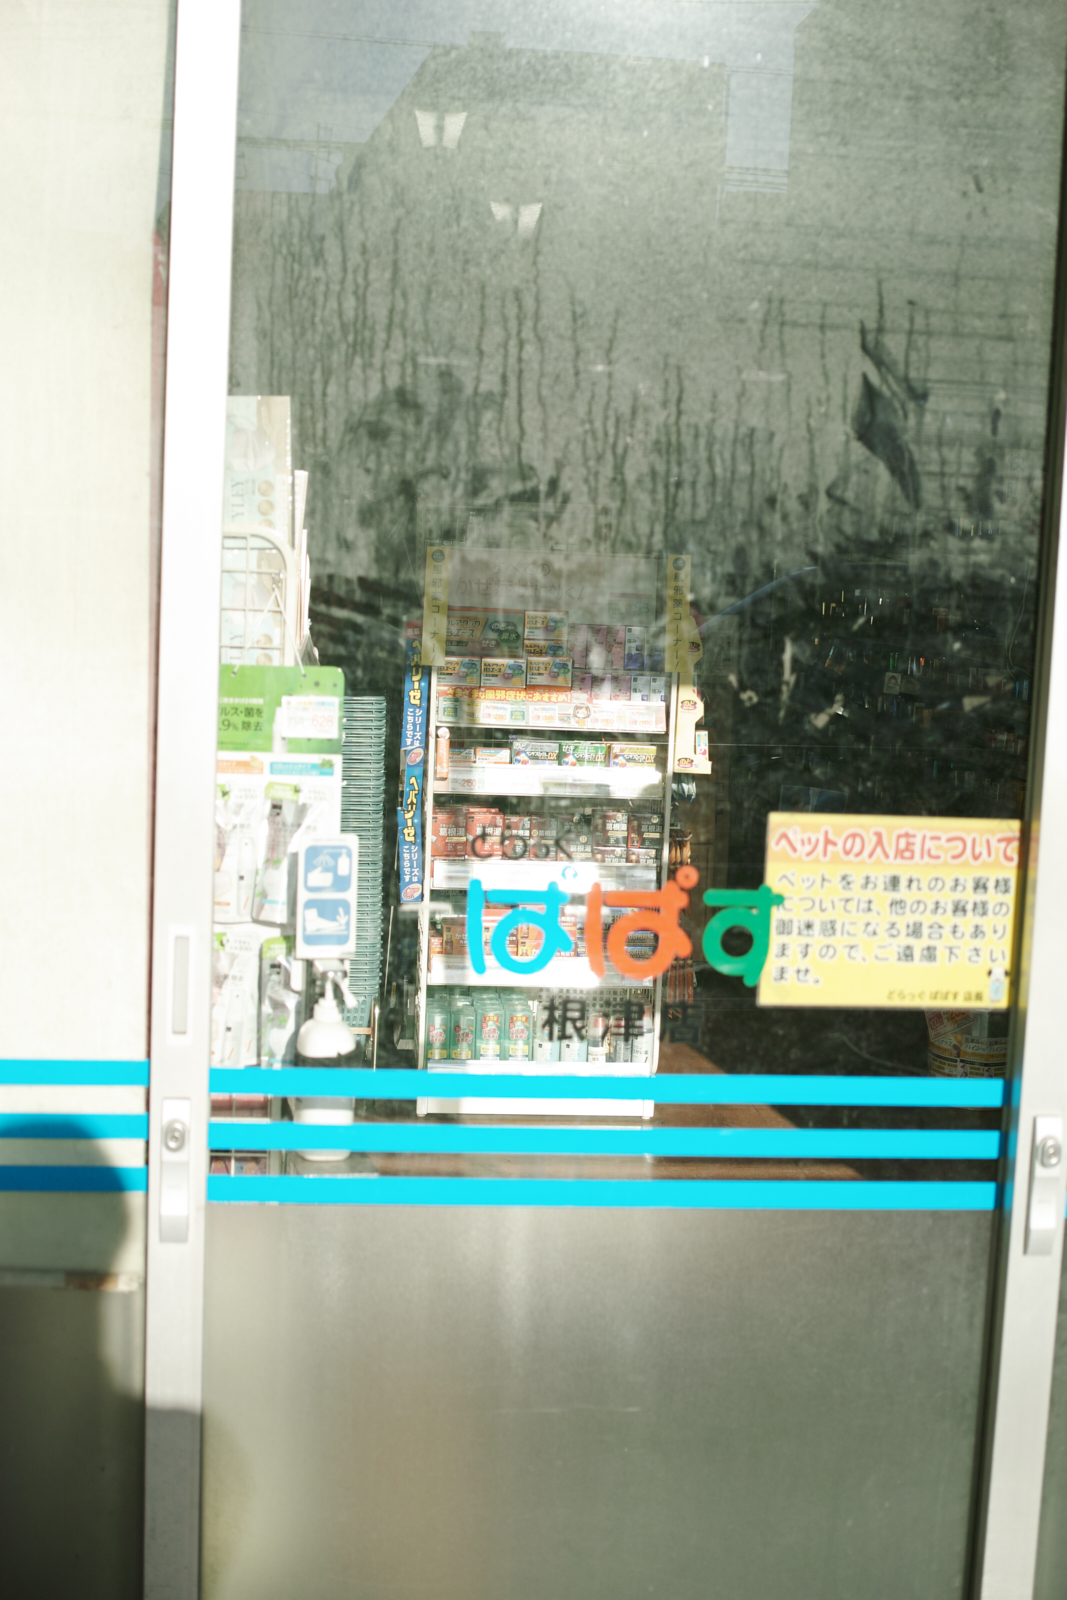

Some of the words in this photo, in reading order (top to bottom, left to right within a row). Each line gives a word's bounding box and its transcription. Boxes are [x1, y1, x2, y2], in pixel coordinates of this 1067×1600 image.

[673, 572, 684, 671] 風邪薬コーナー!
[446, 687, 572, 703] さまざまな風邪症状におすすめ!
[312, 714, 334, 728] 628
[774, 829, 1020, 863] ペットの入店について
[778, 872, 1012, 896] ペットをお連れのお客様
[777, 896, 1010, 919] については、他のお客様の
[466, 865, 785, 987] ぱぱす
[775, 918, 1007, 941] 御迷惑になる場合もあり
[774, 942, 1006, 964] ますので、ご遠慮下さい
[773, 966, 822, 985] ませ。
[541, 998, 704, 1044] 根津店
